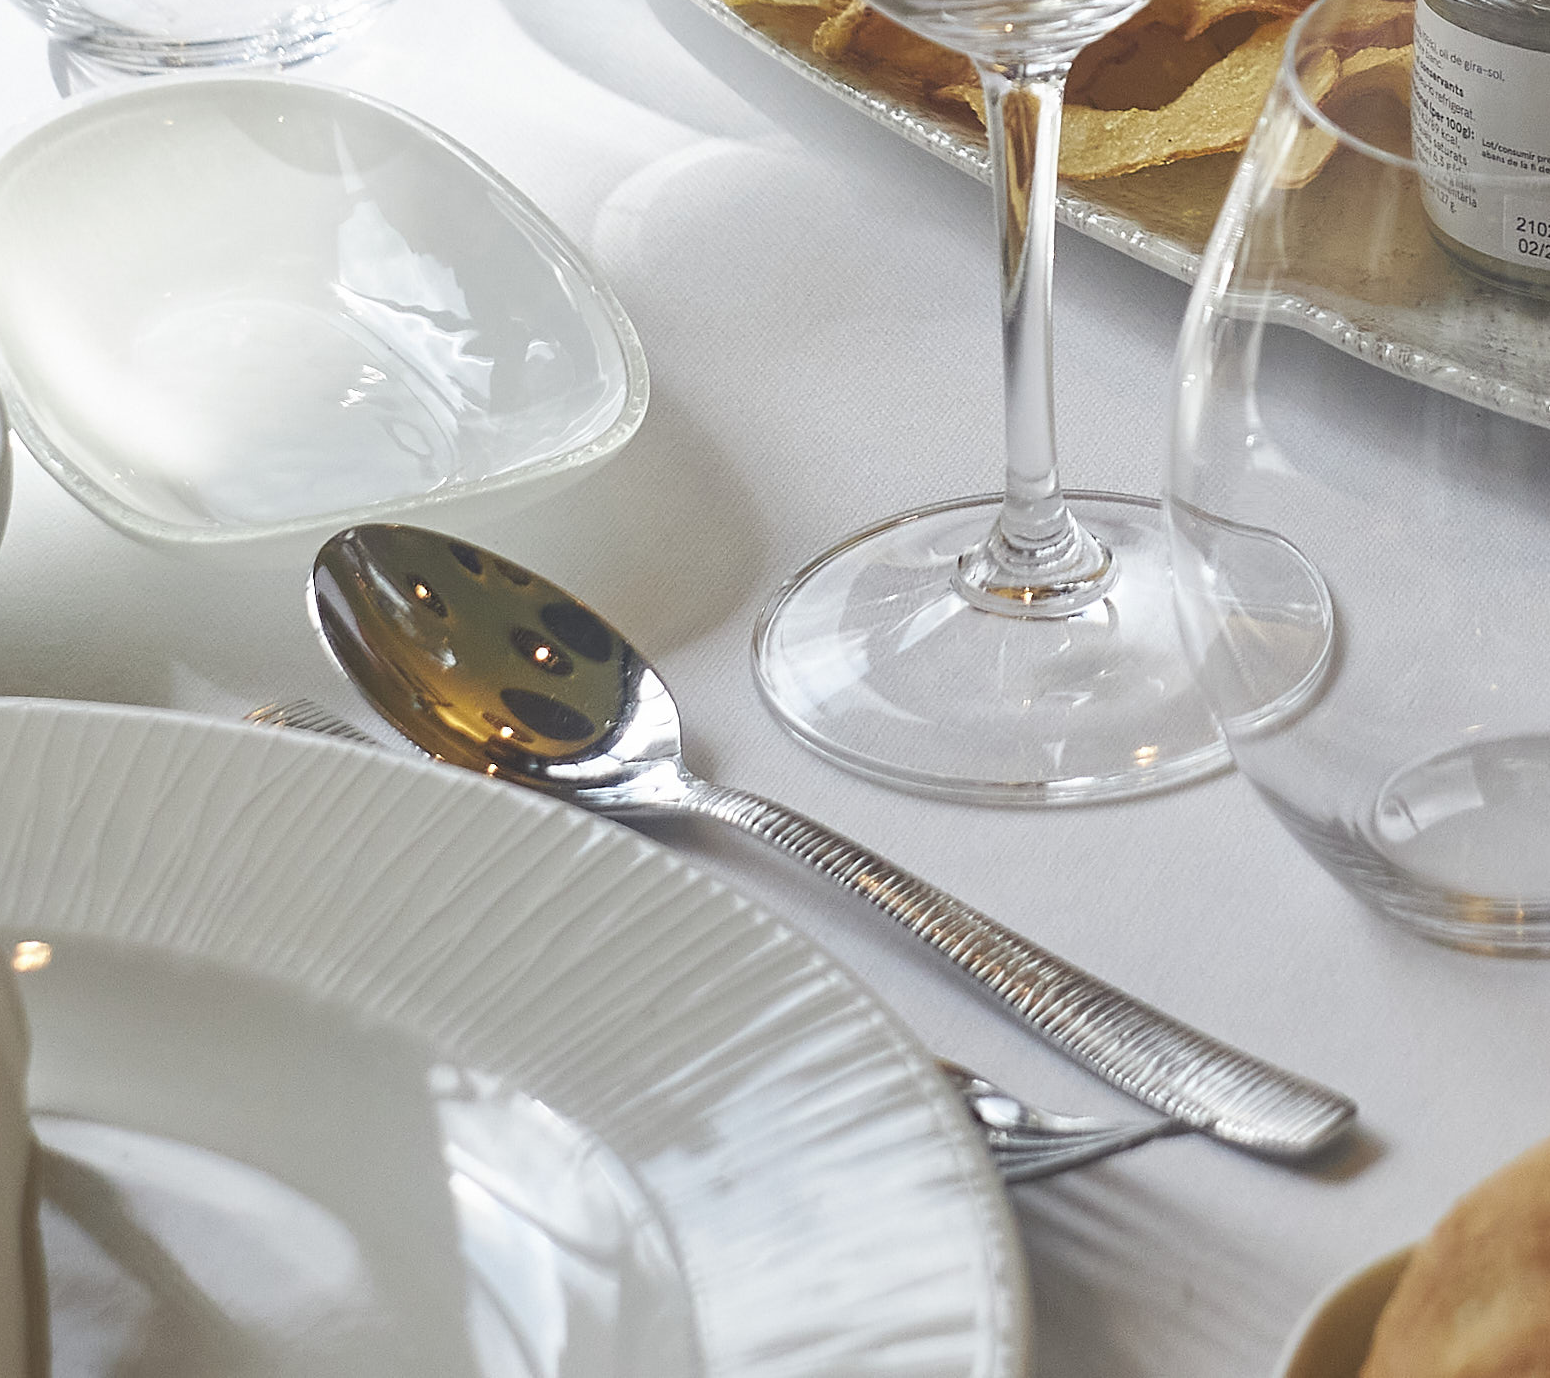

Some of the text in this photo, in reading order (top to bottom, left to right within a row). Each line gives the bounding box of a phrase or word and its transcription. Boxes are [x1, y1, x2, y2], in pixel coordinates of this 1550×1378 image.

[1464, 59, 1505, 82] gira-sol.
[1481, 150, 1506, 164] abans
[1507, 158, 1519, 168] de
